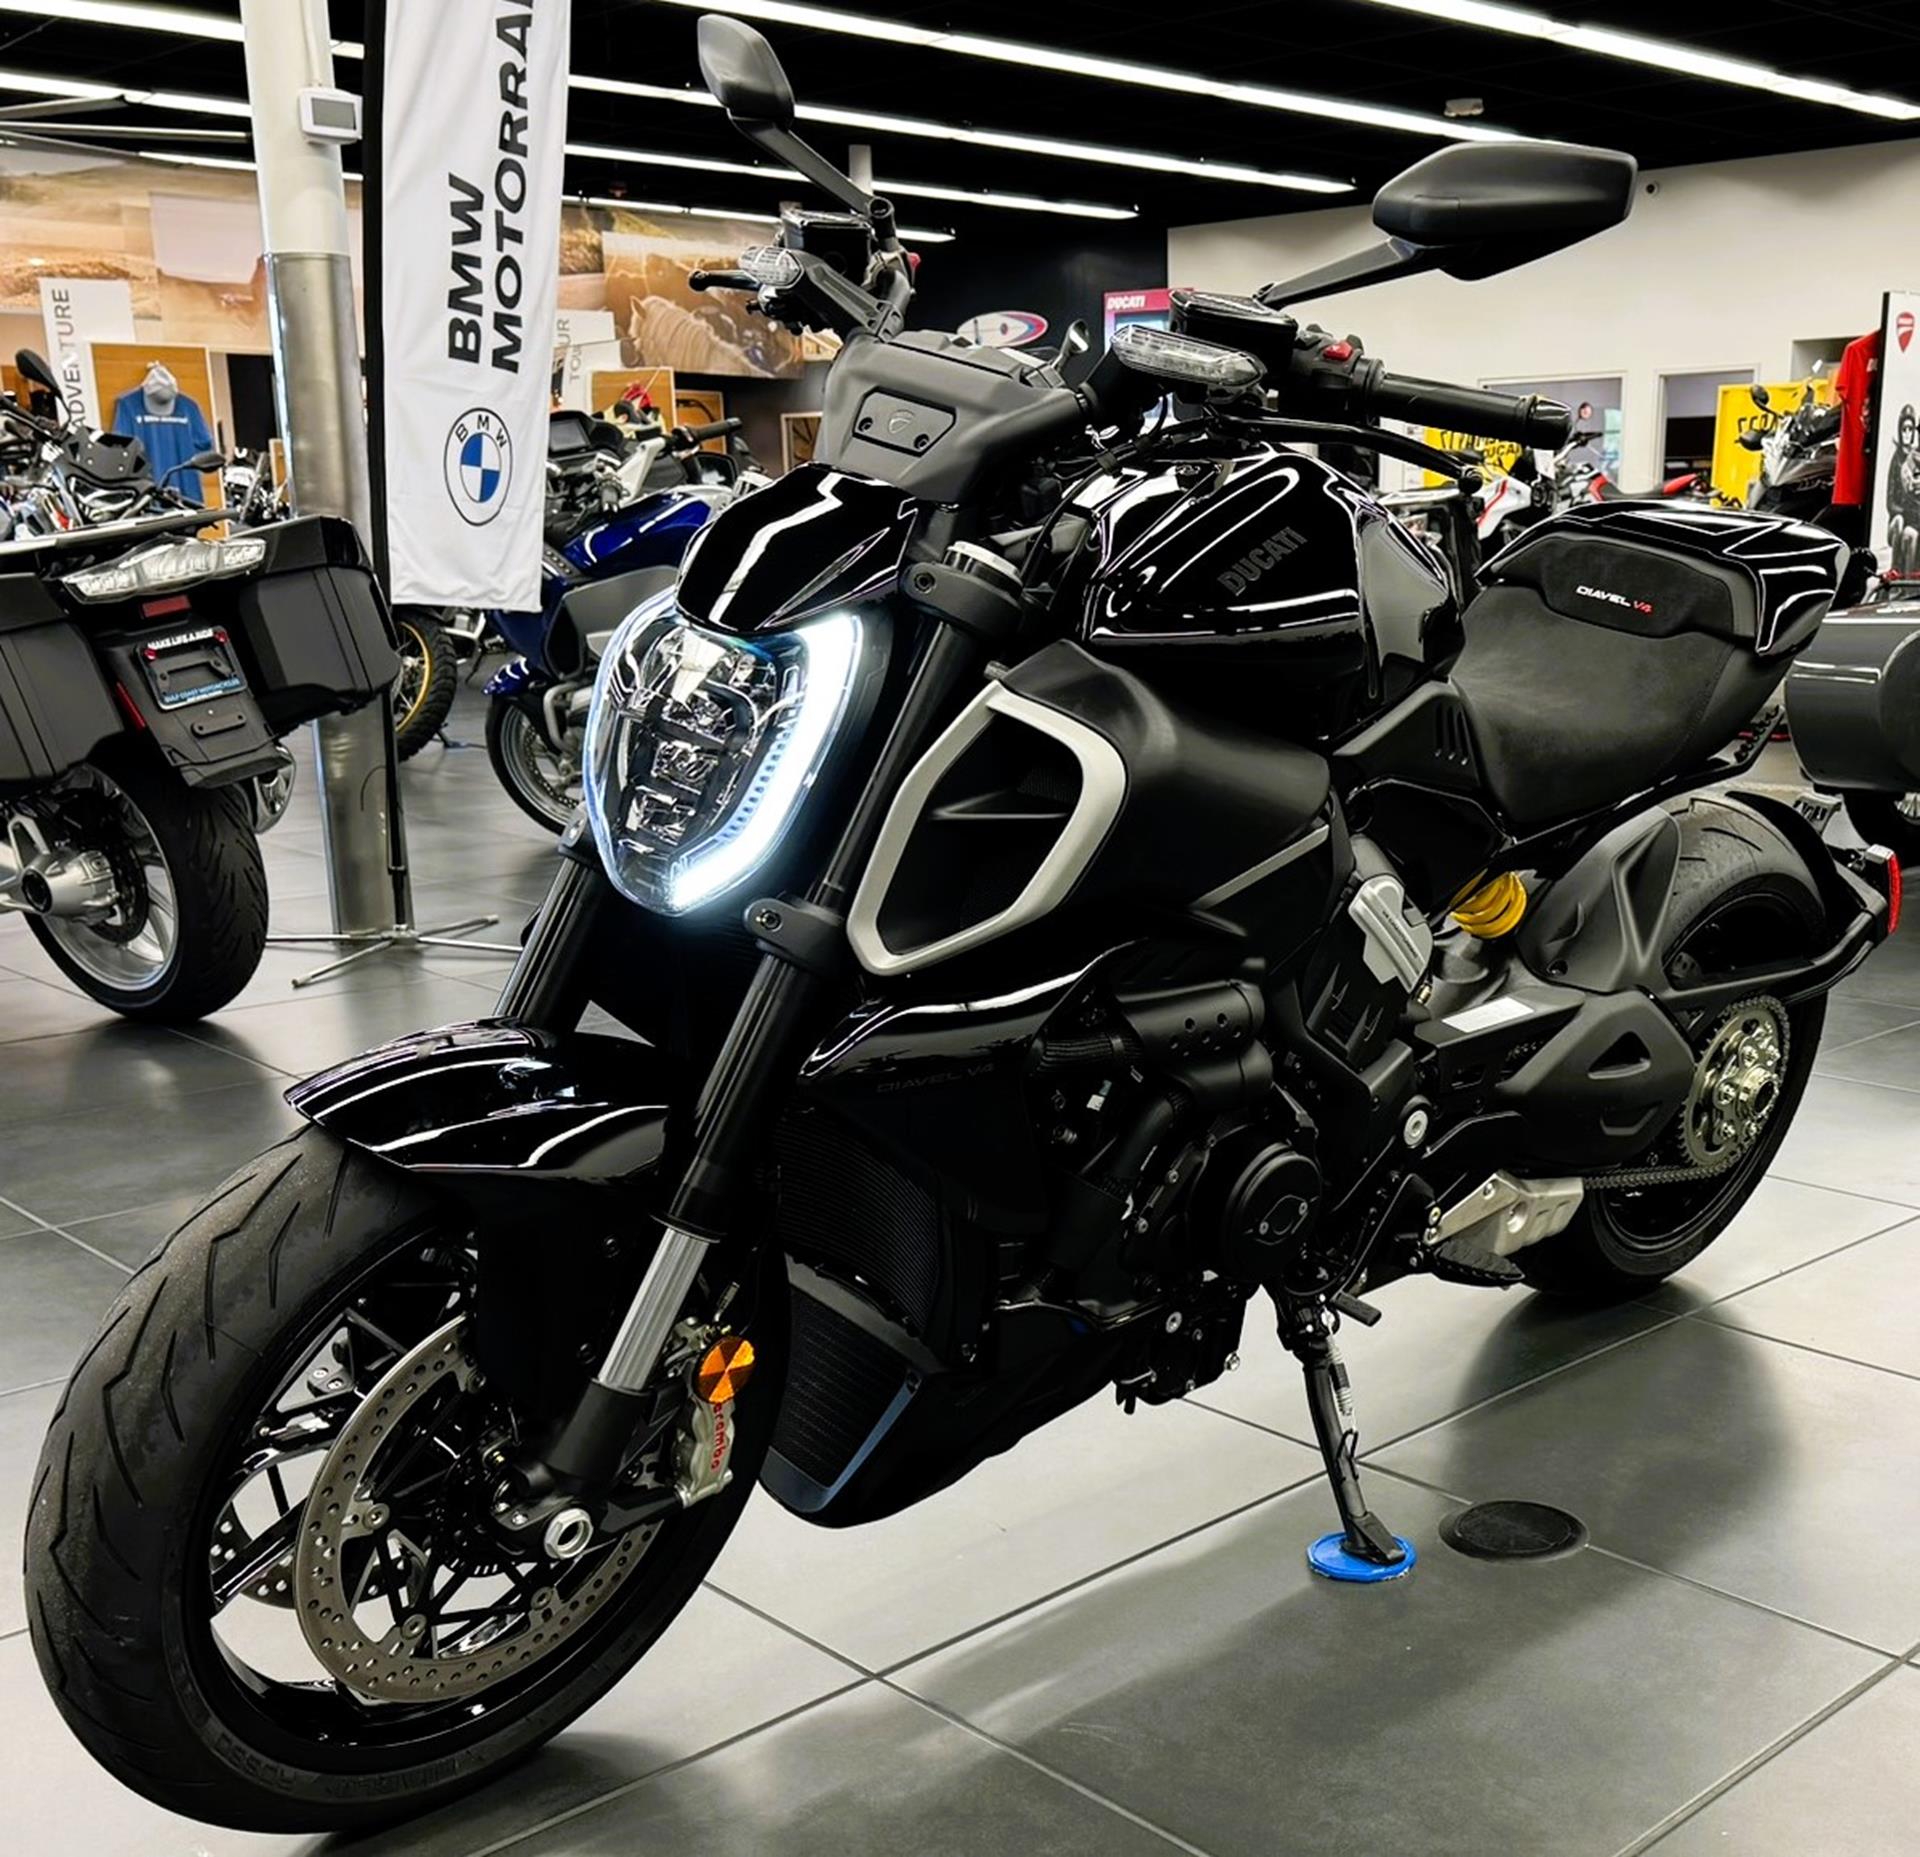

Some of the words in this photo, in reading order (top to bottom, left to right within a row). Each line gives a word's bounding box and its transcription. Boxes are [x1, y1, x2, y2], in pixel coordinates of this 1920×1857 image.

[492, 0, 533, 374] MOTORRA
[448, 172, 484, 364] BMW
[1106, 295, 1146, 310] DUCATI
[455, 414, 507, 448] BMW
[1217, 526, 1307, 596] DUCATI
[1576, 585, 1631, 607] DIAVEL
[1633, 600, 1652, 613] V4
[877, 1072, 962, 1092] DIAVEL
